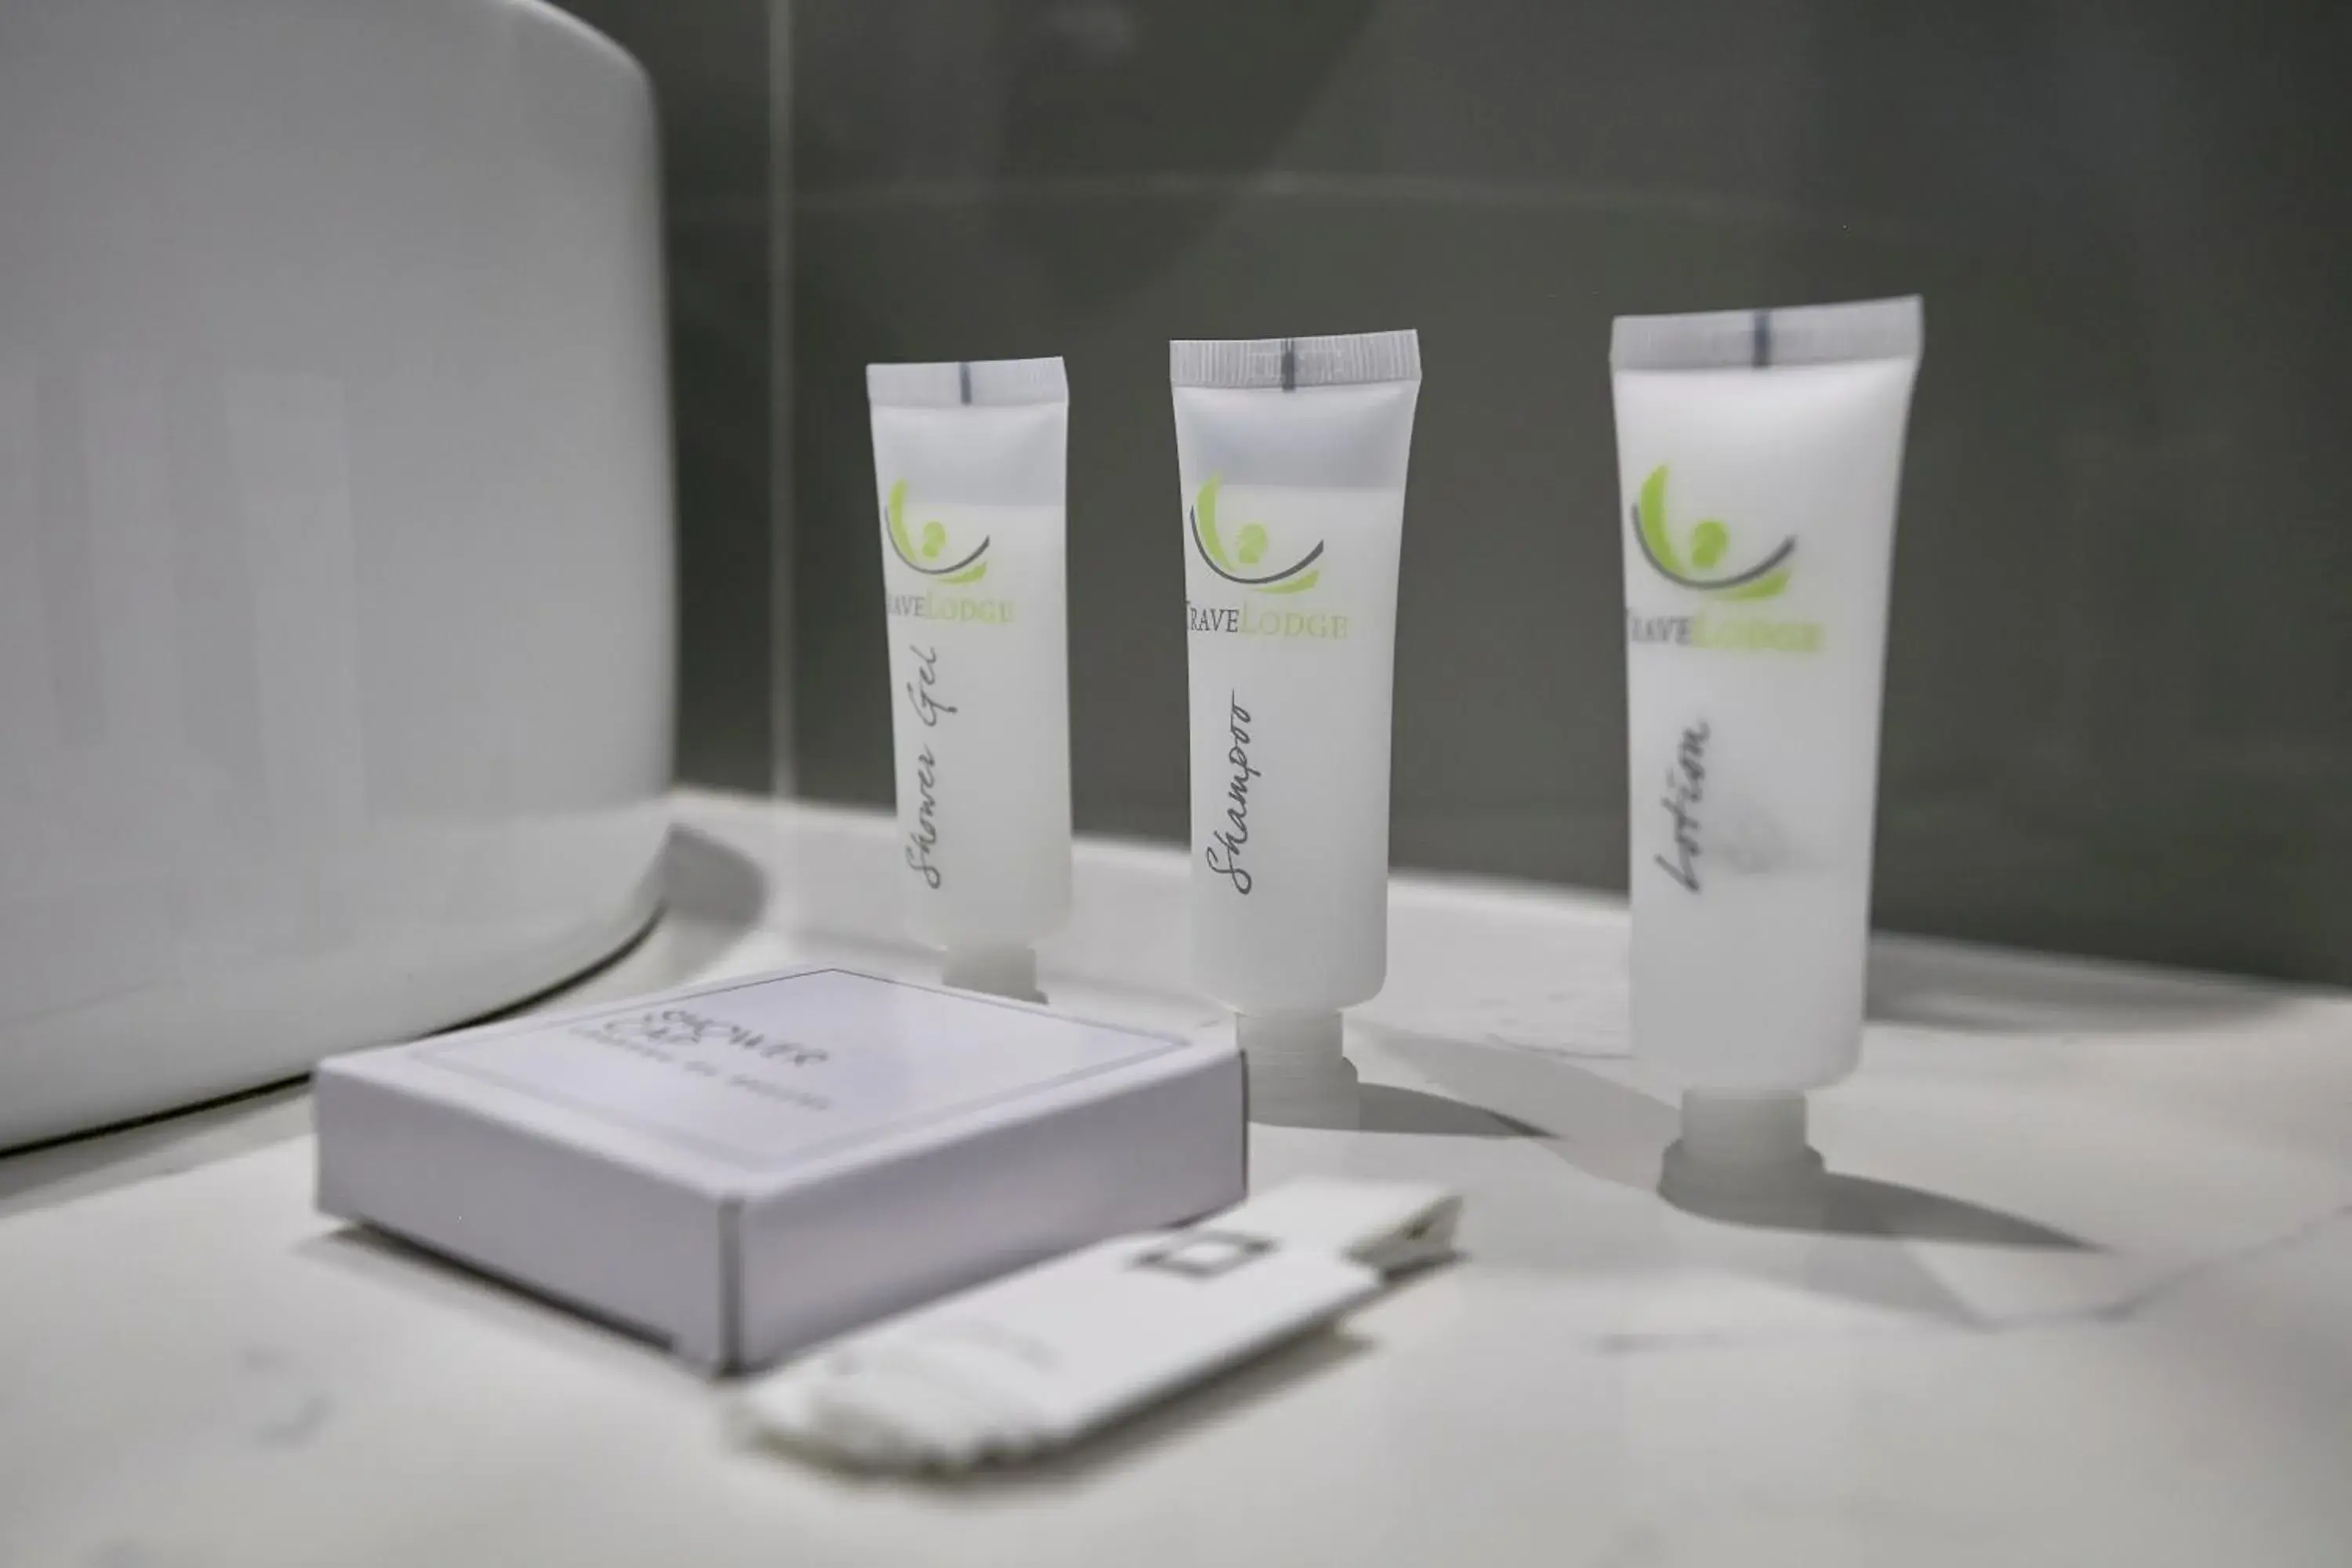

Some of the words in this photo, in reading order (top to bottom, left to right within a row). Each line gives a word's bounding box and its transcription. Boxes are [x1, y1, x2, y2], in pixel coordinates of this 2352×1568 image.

[906, 643, 958, 728] Gel
[905, 743, 942, 890] Shower
[1206, 688, 1261, 895] Shampoo
[1653, 717, 1711, 895] Lotion
